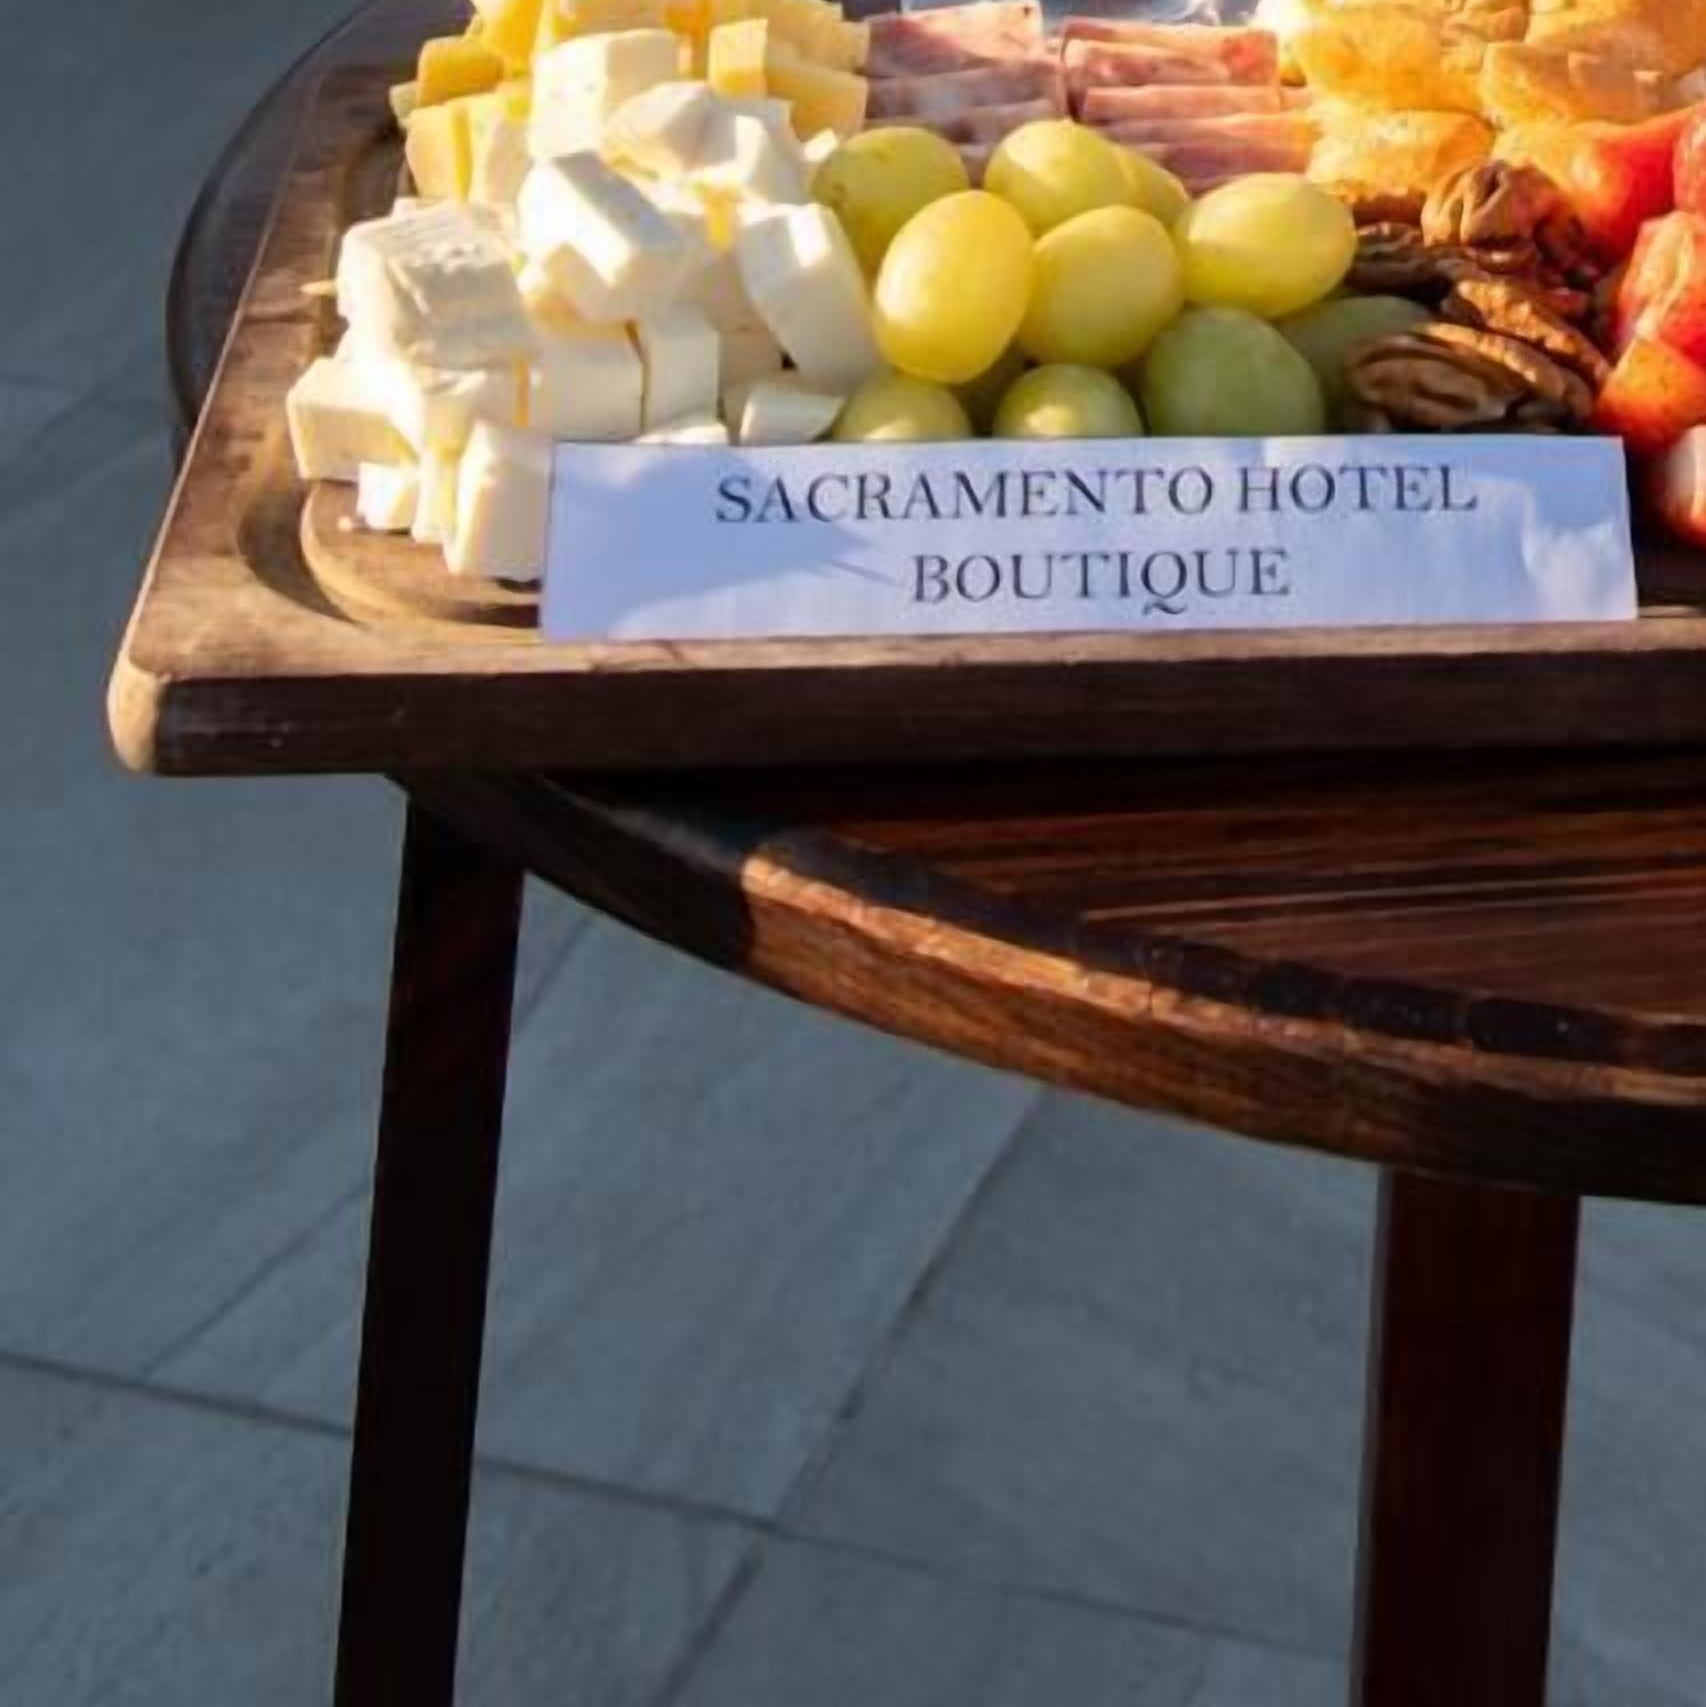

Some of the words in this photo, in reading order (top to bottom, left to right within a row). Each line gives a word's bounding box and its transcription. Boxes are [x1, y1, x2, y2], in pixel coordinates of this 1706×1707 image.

[715, 465, 1214, 524] SACRAMENTO
[1239, 462, 1478, 514] HOTEL
[913, 547, 1291, 616] BOUTIQUE
